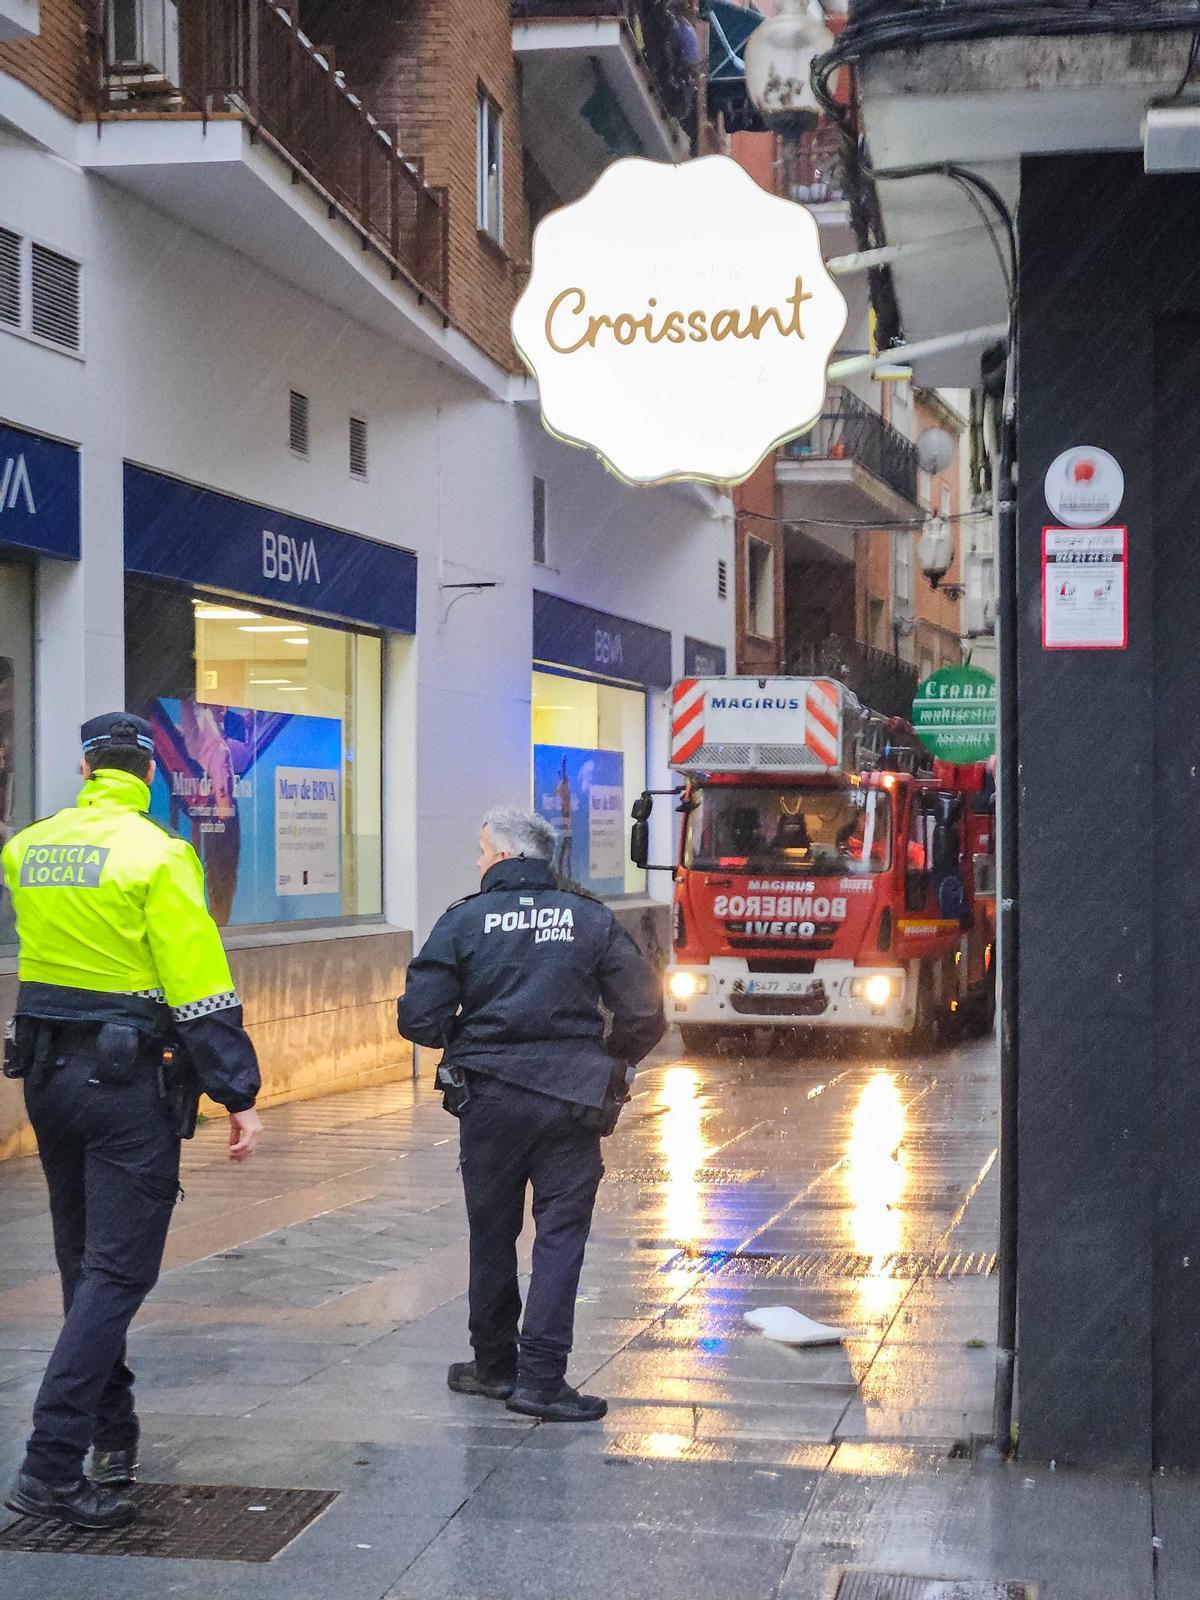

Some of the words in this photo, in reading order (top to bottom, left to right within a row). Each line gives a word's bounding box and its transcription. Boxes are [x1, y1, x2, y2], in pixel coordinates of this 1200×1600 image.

[545, 275, 813, 354] Croissant
[262, 529, 321, 585] BBVA
[711, 697, 799, 710] MAGIRUS
[24, 847, 101, 866] POLICIA
[28, 866, 86, 884] LOCAL
[748, 881, 816, 893] MAGIRUS
[484, 908, 575, 934] POLICIA
[745, 921, 816, 937] IVECO
[534, 928, 575, 944] LOCAL
